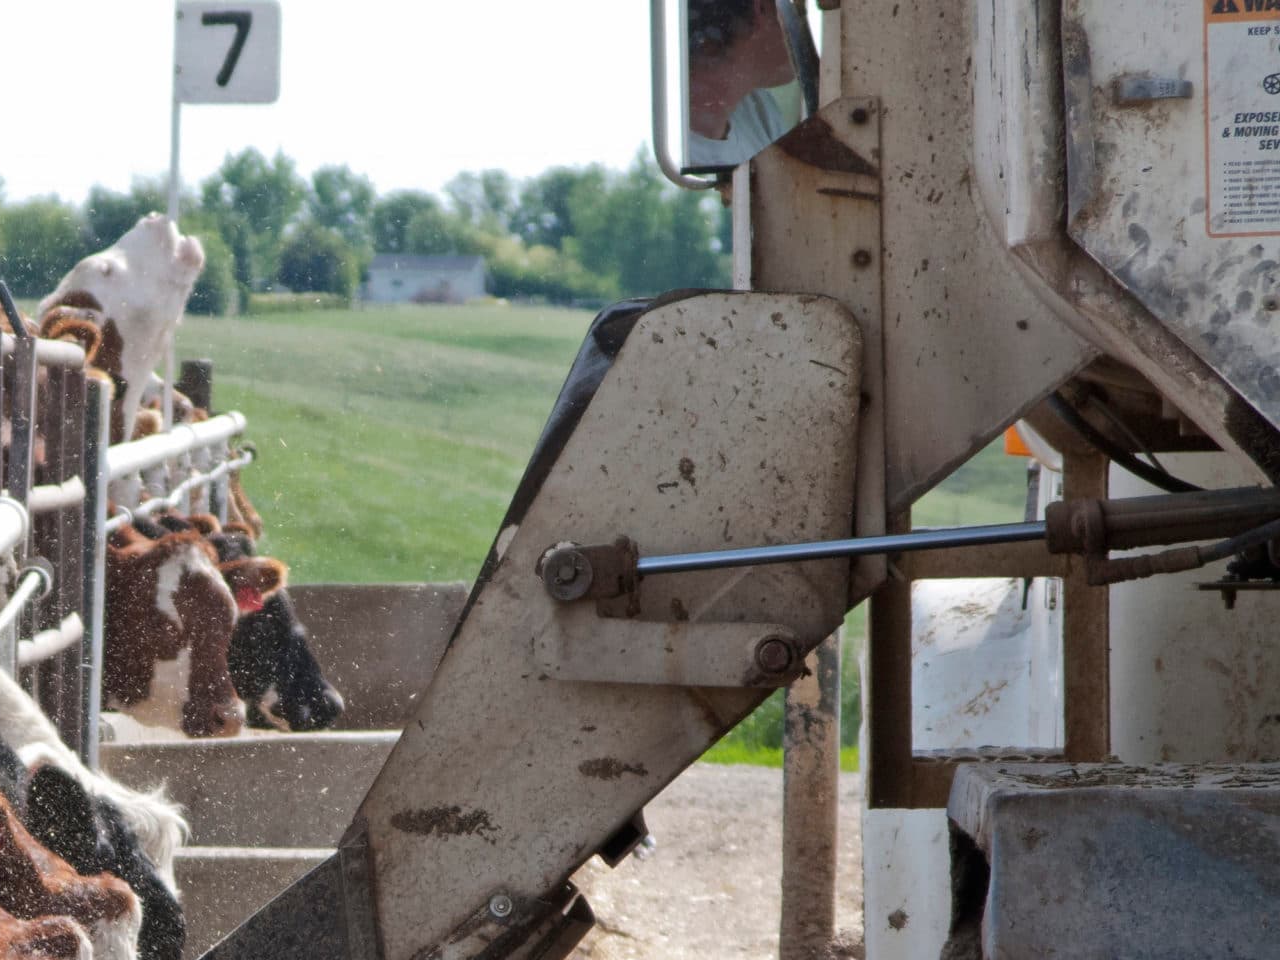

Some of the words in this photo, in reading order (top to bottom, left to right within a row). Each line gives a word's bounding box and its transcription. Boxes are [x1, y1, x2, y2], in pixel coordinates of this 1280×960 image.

[1248, 26, 1271, 36] KEEP
[201, 11, 252, 87] 7
[1222, 127, 1231, 138] &
[1234, 125, 1279, 137] MOVING
